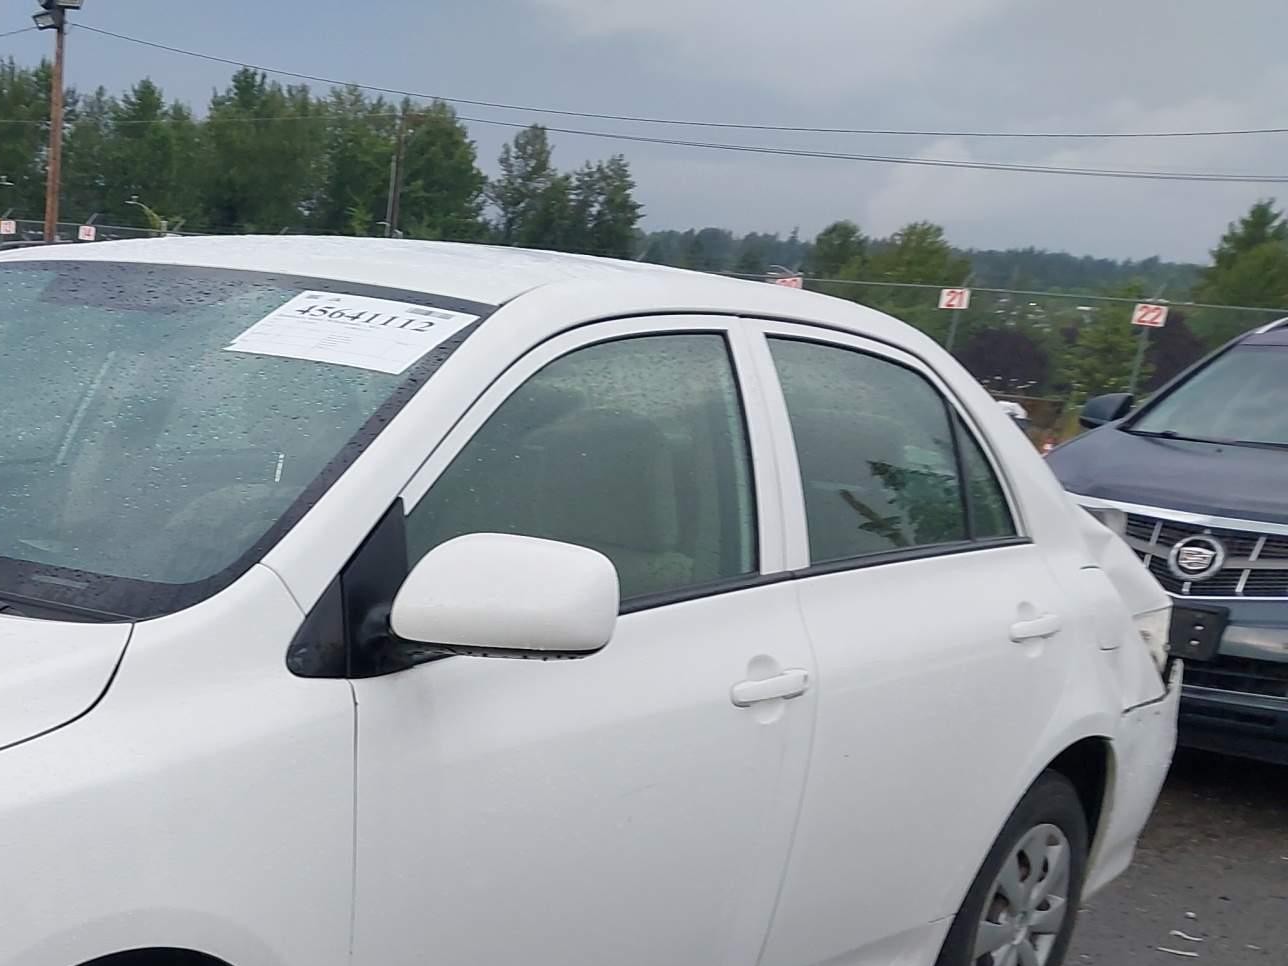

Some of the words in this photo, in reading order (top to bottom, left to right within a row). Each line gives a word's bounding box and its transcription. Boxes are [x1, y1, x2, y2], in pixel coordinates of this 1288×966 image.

[945, 289, 965, 307] 21
[296, 304, 435, 332] 45641112
[1136, 305, 1161, 324] 22
